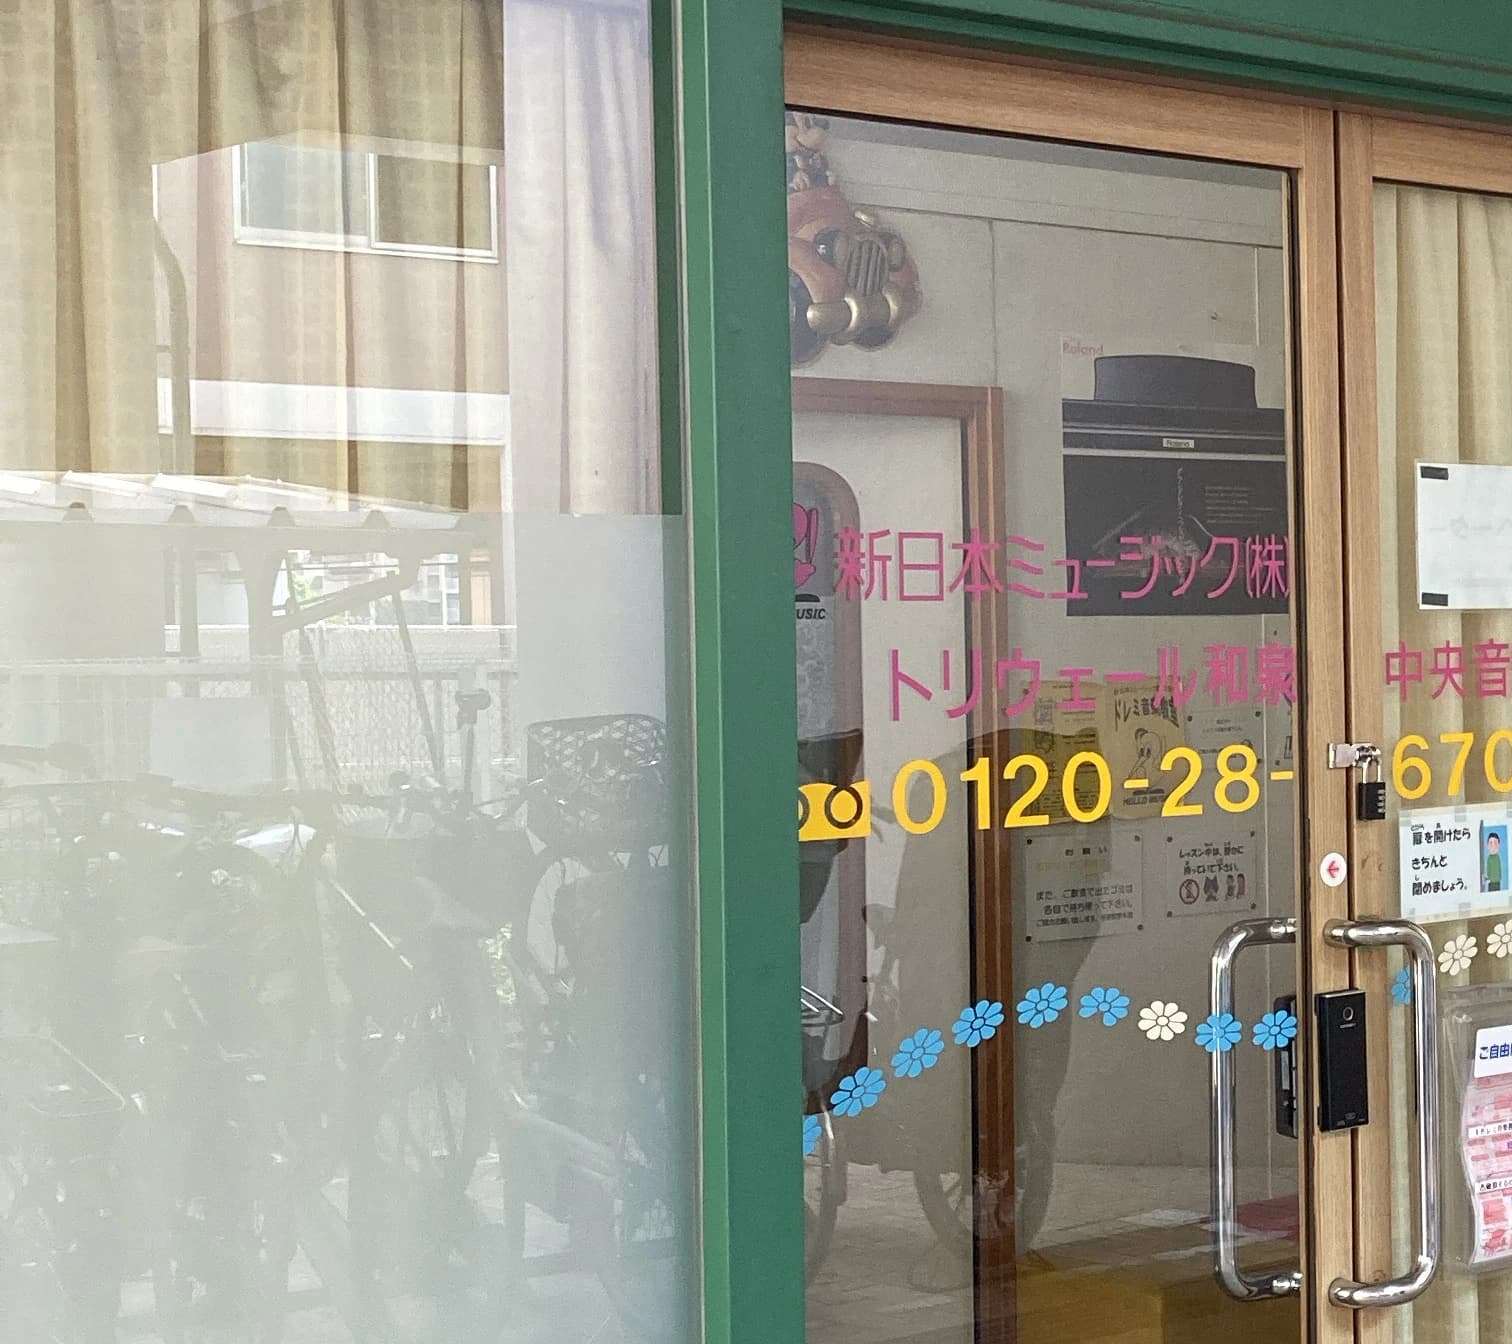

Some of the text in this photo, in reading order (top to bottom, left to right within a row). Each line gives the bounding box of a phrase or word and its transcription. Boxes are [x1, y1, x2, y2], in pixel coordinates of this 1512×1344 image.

[1063, 342, 1104, 355] Roland
[796, 608, 826, 620] USIC
[1412, 828, 1471, 845] 扉を開けたら
[1411, 855, 1448, 870] きちんと
